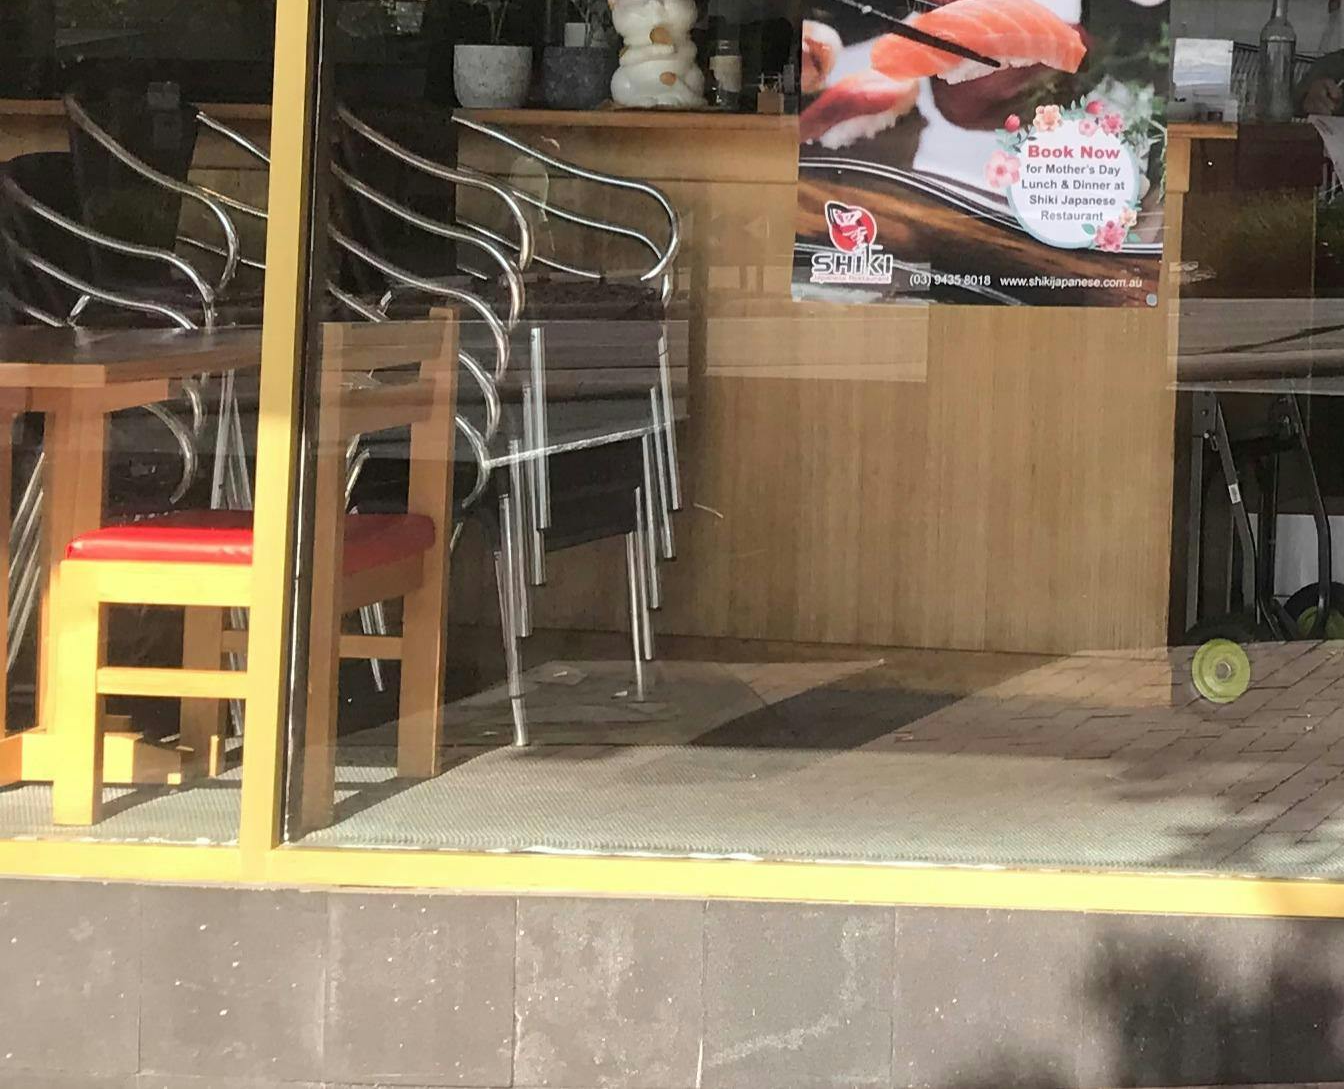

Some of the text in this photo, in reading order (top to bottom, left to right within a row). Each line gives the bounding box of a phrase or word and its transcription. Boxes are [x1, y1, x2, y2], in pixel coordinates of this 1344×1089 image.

[1028, 145, 1120, 159] Book Now
[1026, 163, 1120, 177] for Mother's Day
[1021, 179, 1125, 190] Lunch & Dinner at
[1029, 194, 1116, 207] Shiki Japanese
[1041, 210, 1103, 221] Restaurant
[811, 248, 894, 275] SHIKI
[909, 274, 1142, 289] (03) 9435 8018 www.shikijapanese.com.au
